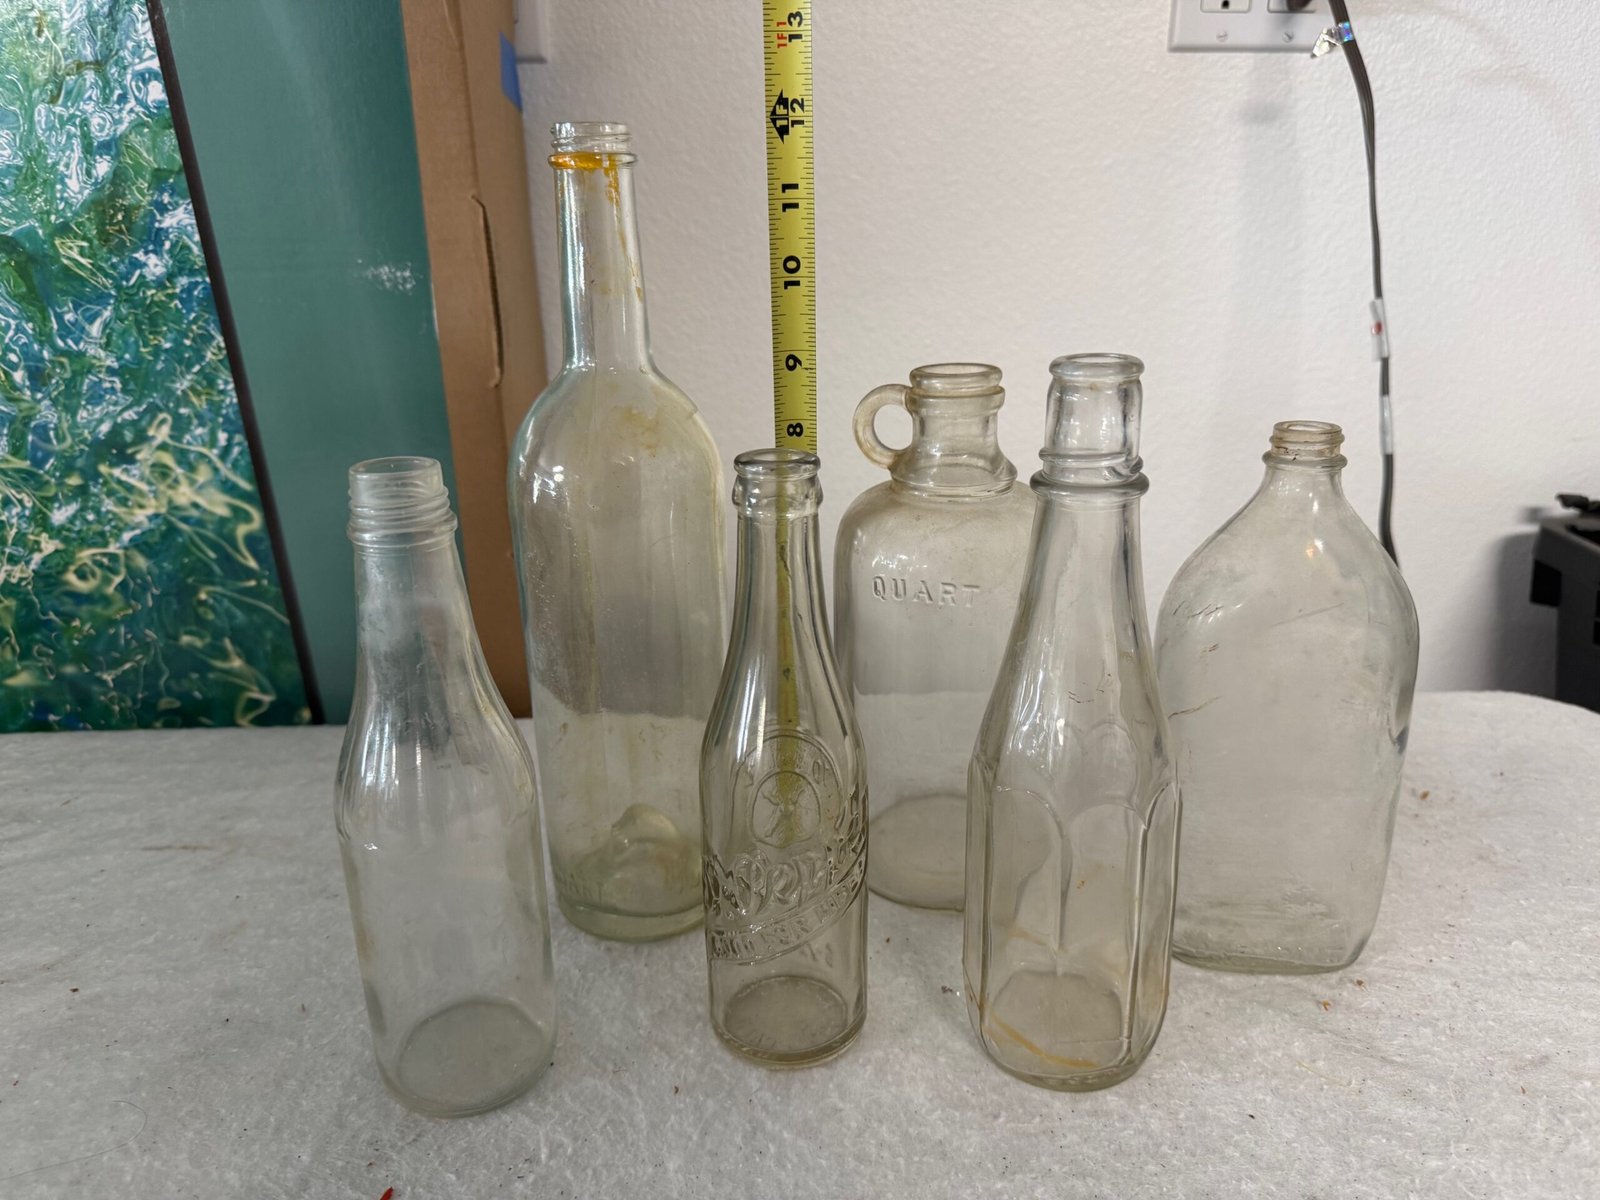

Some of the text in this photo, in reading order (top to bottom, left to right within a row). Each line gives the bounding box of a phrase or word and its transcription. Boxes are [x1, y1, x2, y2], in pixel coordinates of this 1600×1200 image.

[788, 10, 803, 42] 13
[790, 97, 805, 128] 12
[781, 183, 799, 212] 11
[782, 255, 801, 290] 10
[785, 354, 803, 372] 9
[787, 422, 804, 437] 8
[873, 576, 980, 607] QUART
